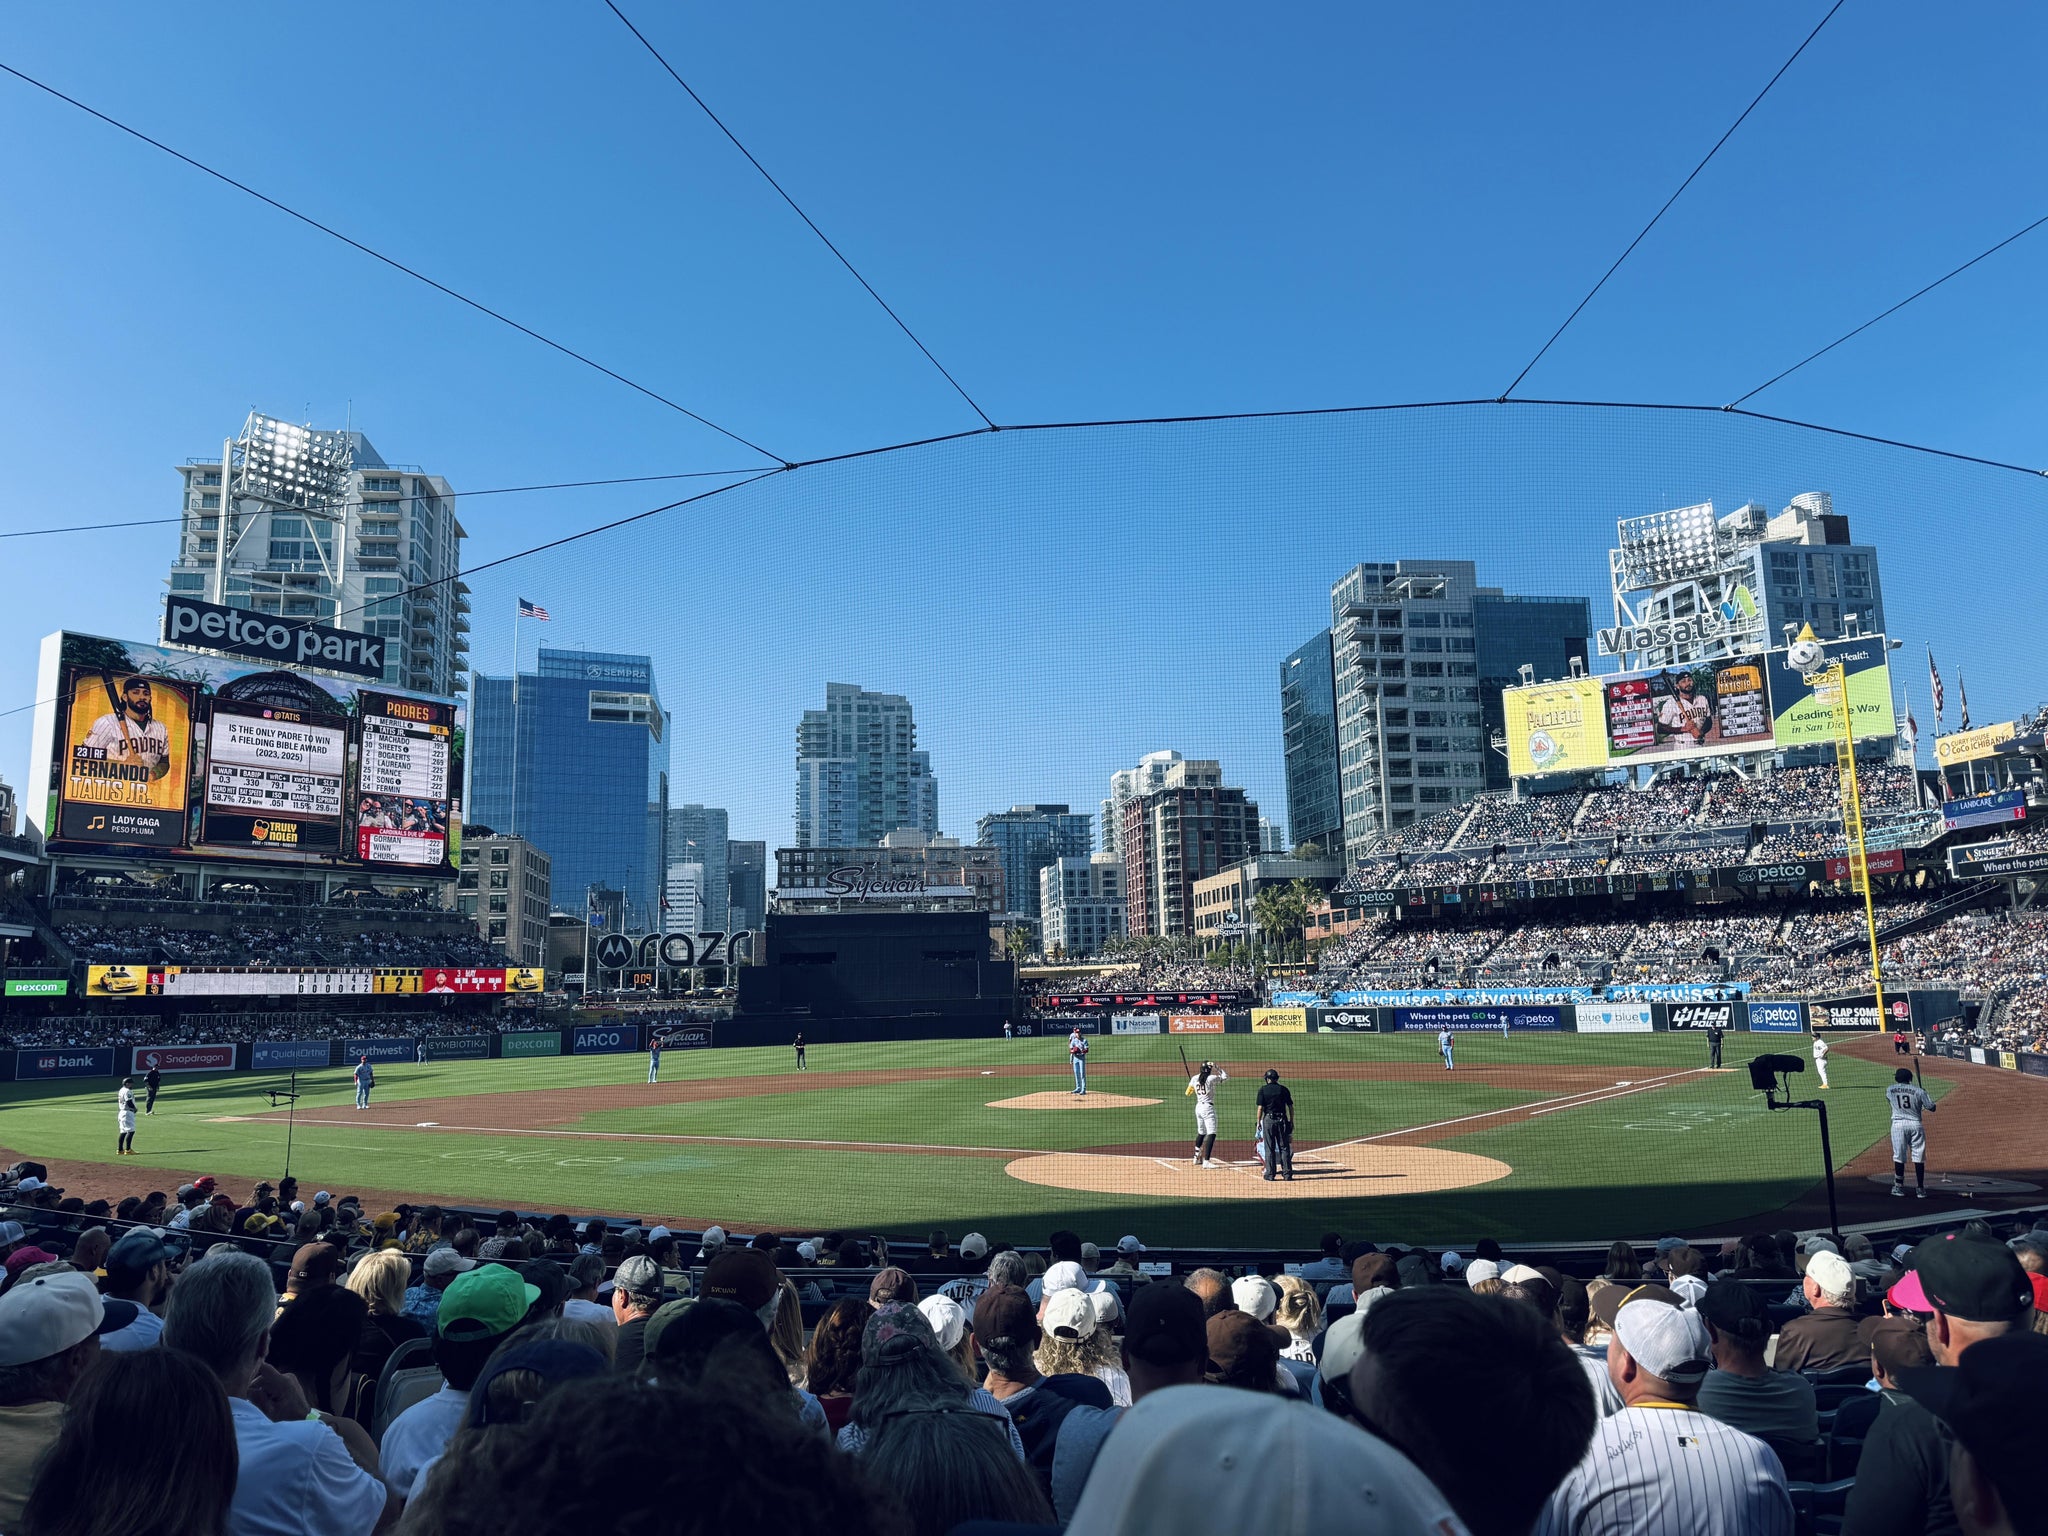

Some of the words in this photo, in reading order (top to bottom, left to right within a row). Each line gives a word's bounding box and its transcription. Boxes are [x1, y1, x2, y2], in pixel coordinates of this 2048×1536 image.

[170, 604, 291, 650] petco
[296, 629, 382, 668] park
[1600, 614, 1711, 653] Viasat
[1840, 651, 1869, 661] Health
[603, 669, 647, 678] SEMPRA
[274, 710, 300, 722] @TATIS
[387, 701, 429, 720] PADRES
[1790, 710, 1834, 722] Leading
[1856, 703, 1880, 713] Way
[379, 718, 406, 728] MERRILL
[1791, 725, 1801, 734] in
[1805, 722, 1824, 732] San
[229, 723, 237, 732] IS
[238, 725, 254, 735] THE
[255, 727, 276, 737] ONLY
[277, 730, 302, 741] PADRE
[304, 734, 314, 743] TO
[315, 735, 331, 745] WIN
[379, 727, 396, 735] TATIS
[230, 735, 237, 743] A
[238, 735, 275, 748] FIELDING
[276, 741, 298, 750] BIBLE
[300, 743, 328, 754] AWARD
[379, 735, 410, 745] MACHADO
[1950, 738, 1969, 747] CURRY
[1970, 733, 1990, 742] HOUSE
[77, 747, 87, 757] 23
[94, 749, 105, 759] RF
[378, 743, 402, 752] SHEETS
[1951, 745, 1970, 754] CoCo
[256, 748, 280, 760] (2023,
[281, 751, 303, 762] 2025)
[378, 751, 411, 761] BOGAERTS
[377, 759, 411, 770] LAUREANO
[71, 759, 150, 782] FERNANDO
[377, 768, 402, 777] FRANCE
[219, 775, 231, 784] 0.3
[243, 779, 260, 787] .330
[271, 782, 284, 790] 79.1
[376, 776, 394, 784] SONG
[70, 776, 124, 802] TATIS
[126, 782, 152, 804] JR.
[376, 785, 400, 793] FERMIN
[212, 794, 235, 803] 58.7%
[238, 796, 252, 804] 72.9
[1960, 798, 1992, 809] LANDCARE
[112, 815, 135, 825] LADY
[137, 817, 160, 827] GAGA
[112, 826, 130, 834] PESO
[131, 827, 154, 835] PLUMA
[270, 822, 297, 833] TRULY
[379, 829, 407, 837] CARDINALS
[373, 835, 402, 844] GORMAN
[373, 844, 391, 852] WINN
[373, 852, 400, 860] CHURCH
[1983, 862, 2011, 873] Where
[2012, 860, 2027, 869] the
[1758, 864, 1806, 881] petco
[825, 866, 928, 903] Sycuan
[1360, 891, 1395, 904] petco
[1214, 921, 1250, 931] Gallagher
[1219, 928, 1245, 937] Square
[637, 930, 751, 968] razr
[395, 976, 403, 992] 2
[1452, 1013, 1470, 1021] pets
[1693, 1007, 1730, 1020] H2O
[1765, 1007, 1797, 1024] petco
[1830, 1007, 1853, 1017] SLAP
[1854, 1007, 1879, 1017] SOME
[1526, 1014, 1555, 1025] petco
[1578, 1014, 1601, 1022] blue
[1615, 1014, 1639, 1022] blue
[1831, 1017, 1859, 1025] CHEESE
[1860, 1017, 1872, 1025] ON
[1016, 1025, 1032, 1035] 396
[1405, 1022, 1424, 1031] keep
[576, 1033, 620, 1047] ARCO
[653, 1027, 705, 1047] Sycuan
[349, 1045, 402, 1056] Southwest
[428, 1040, 487, 1050] CYMBIOTIKA
[39, 1059, 56, 1068] us
[58, 1055, 94, 1067] bank
[166, 1054, 224, 1065] Snapdragon
[1196, 1083, 1206, 1095] 29
[1896, 1095, 1911, 1109] 13
[944, 1285, 974, 1299] TATIS
